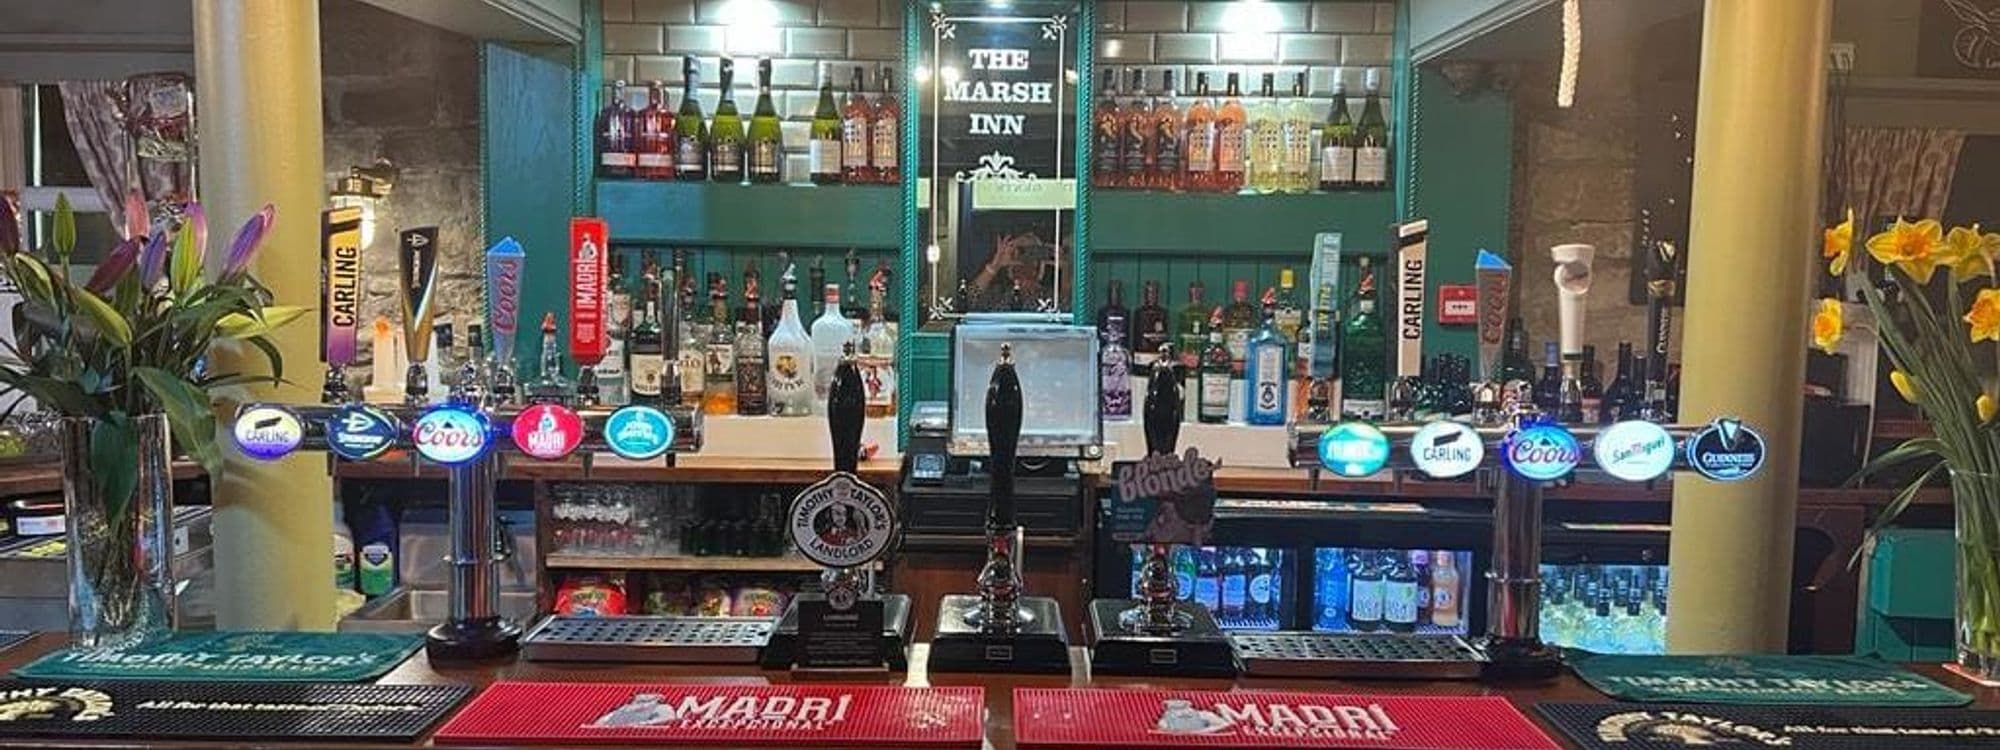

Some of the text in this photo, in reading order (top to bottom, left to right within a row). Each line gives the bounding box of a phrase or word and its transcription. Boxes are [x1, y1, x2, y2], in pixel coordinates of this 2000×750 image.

[969, 49, 1029, 70] THE
[944, 81, 1053, 103] MARSH
[969, 113, 1026, 135] INN
[332, 246, 358, 328] CARLING
[492, 258, 520, 335] Coors
[1403, 258, 1423, 340] CARLING
[245, 429, 289, 443] CARLING
[415, 420, 480, 447] Coors
[1422, 447, 1472, 463] CARLING
[1512, 439, 1581, 464] Coors
[1119, 447, 1212, 502] blonde
[797, 488, 890, 530] TIMOTHY TAYLOR'S
[809, 538, 874, 559] LANDLORD
[62, 651, 378, 665] TIMOTHY TAYLOR'S
